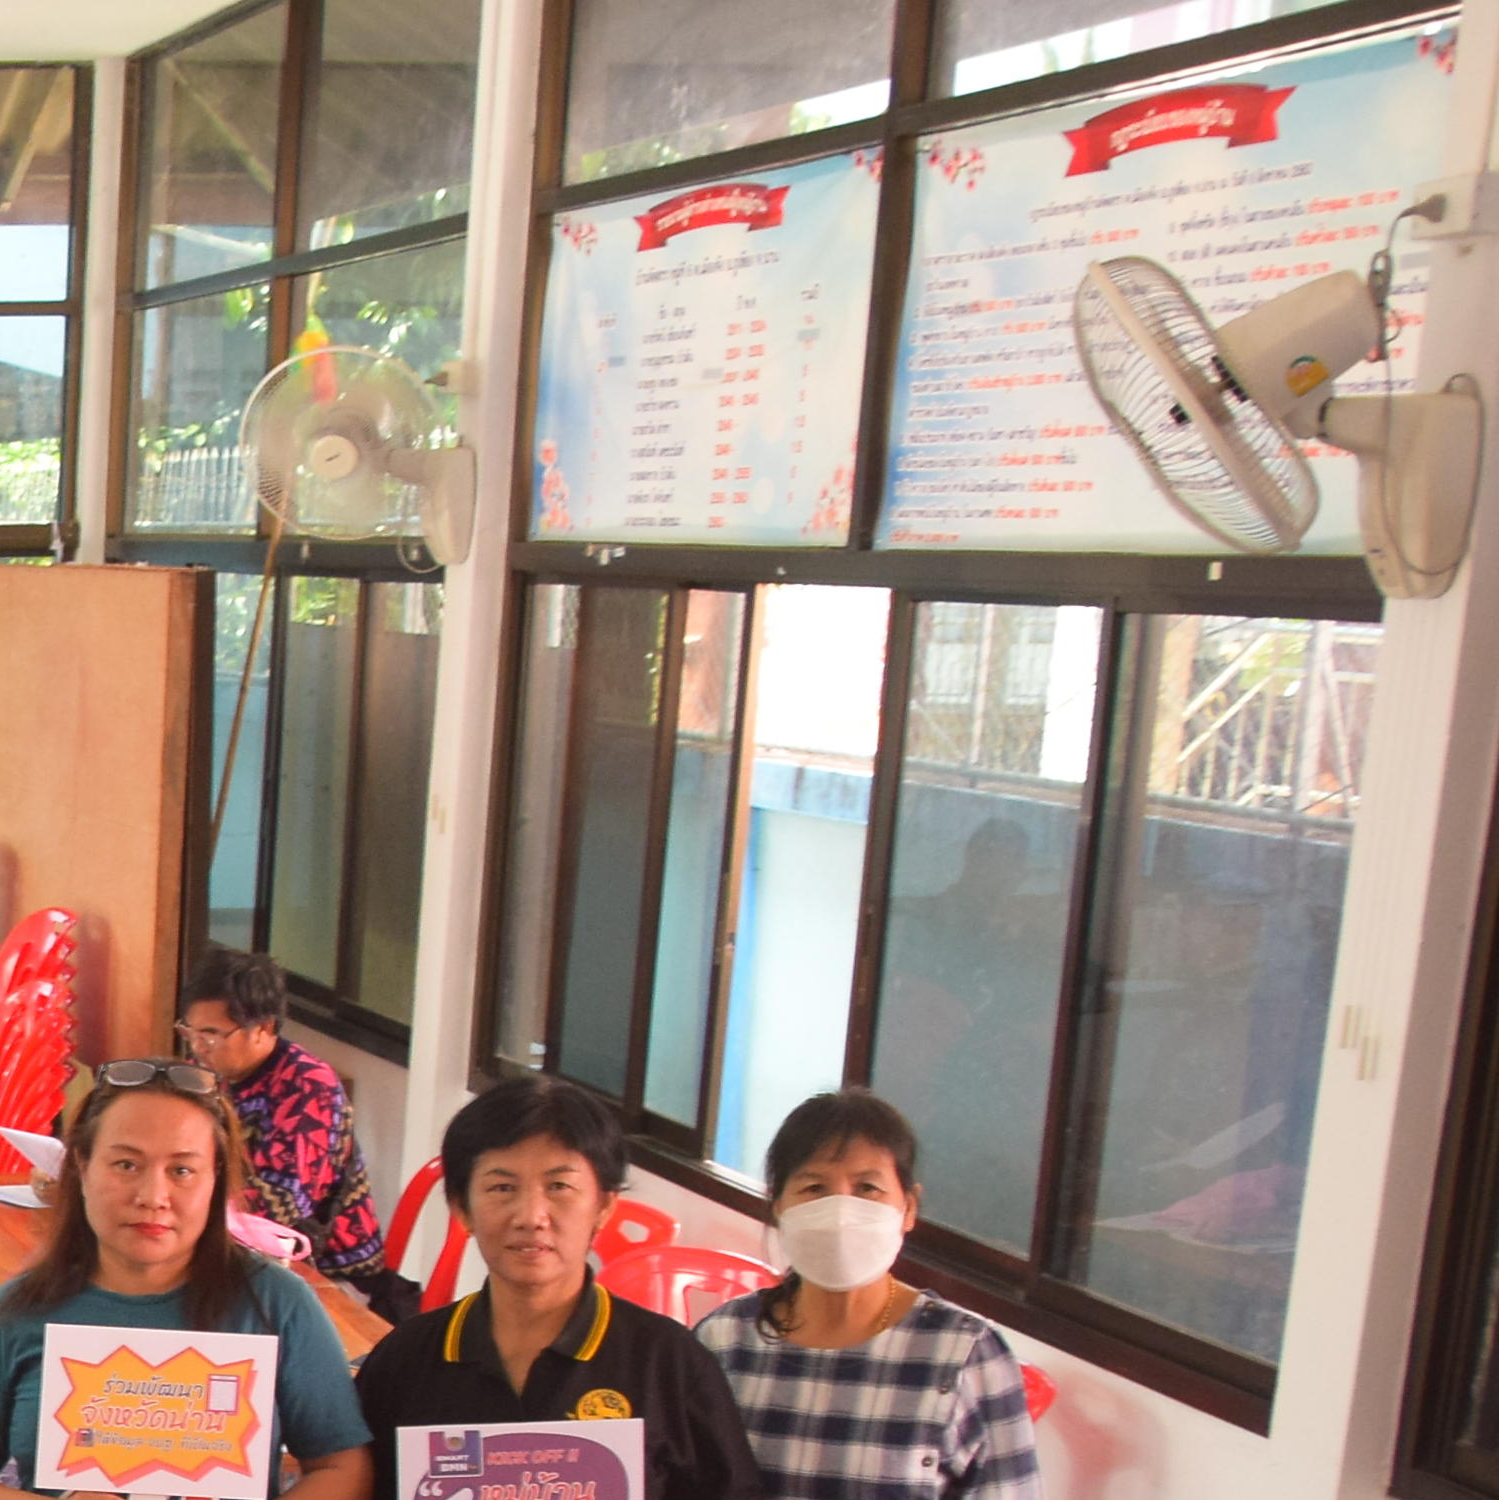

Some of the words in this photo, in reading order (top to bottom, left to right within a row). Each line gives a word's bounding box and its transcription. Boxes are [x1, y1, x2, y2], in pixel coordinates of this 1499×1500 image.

[102, 1372, 206, 1401] ร่วมพัฒนา
[80, 1396, 228, 1433] จังหวัดน่าน
[531, 1449, 566, 1464] OFF
